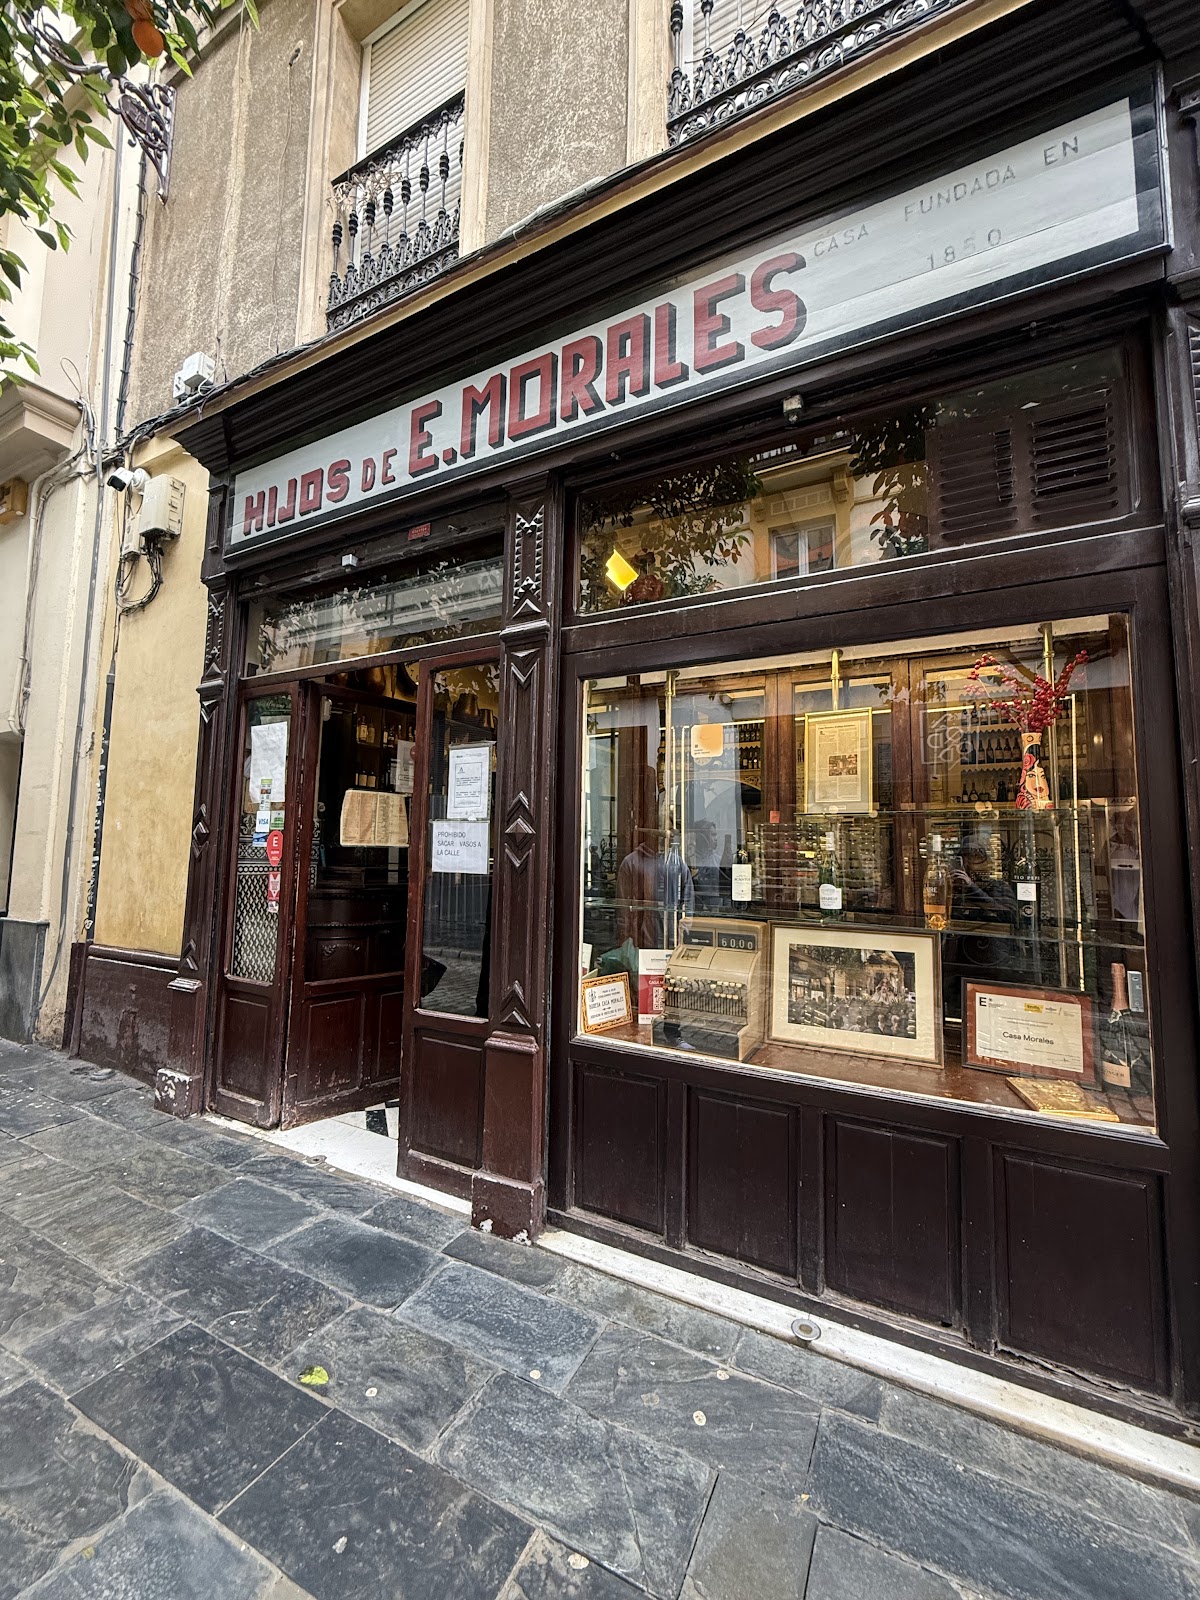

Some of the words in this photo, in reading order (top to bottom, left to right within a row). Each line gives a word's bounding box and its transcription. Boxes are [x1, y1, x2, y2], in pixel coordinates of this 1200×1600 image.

[814, 223, 869, 257] CASA
[903, 164, 1016, 222] FUNDADA
[1044, 135, 1080, 166] EN
[243, 458, 352, 537] HIJOS
[361, 447, 398, 492] DE
[437, 831, 467, 839] PROHIBIDO
[272, 836, 279, 847] E
[459, 840, 477, 848] VASOS
[444, 849, 460, 857] CALLE
[979, 996, 987, 1007] E
[1002, 1031, 1022, 1041] Casa
[1023, 1034, 1054, 1046] Morales
